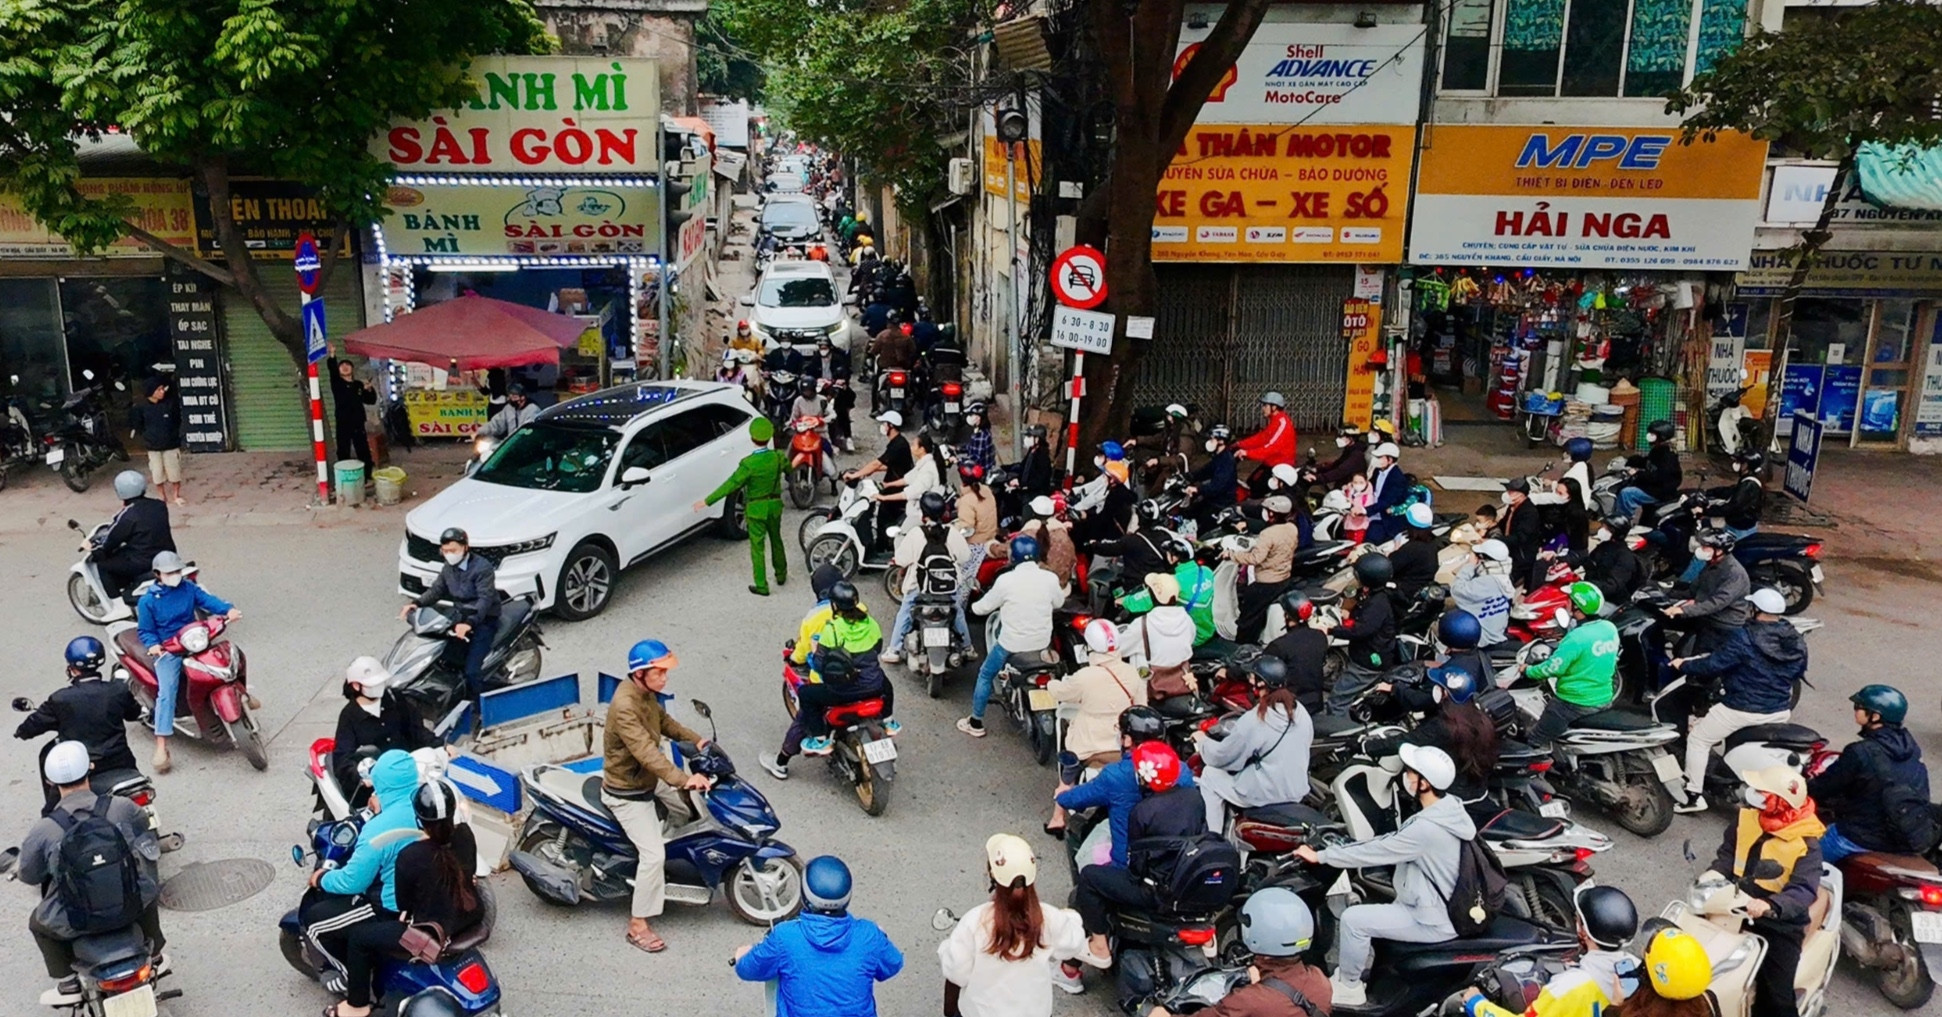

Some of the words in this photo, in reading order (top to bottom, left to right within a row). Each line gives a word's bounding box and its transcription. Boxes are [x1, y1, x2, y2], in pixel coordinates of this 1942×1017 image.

[1287, 45, 1323, 58] Shell
[1265, 60, 1377, 77] ADVANCE
[571, 62, 629, 111] MÌ
[1265, 91, 1341, 103] MotoCare
[388, 117, 491, 164] SÀI
[509, 118, 638, 165] GÒN
[1197, 128, 1277, 157] THÂN
[1286, 133, 1392, 158] MOTOR
[1514, 133, 1673, 170] MPE
[1200, 190, 1246, 218] GA
[1288, 192, 1330, 218] XE
[504, 220, 562, 238] SÀI
[573, 220, 645, 238] GÒN
[1494, 202, 1568, 237] HẢI
[1582, 212, 1671, 239] NGA
[189, 358, 204, 369] PIN
[419, 420, 452, 433] SÀI
